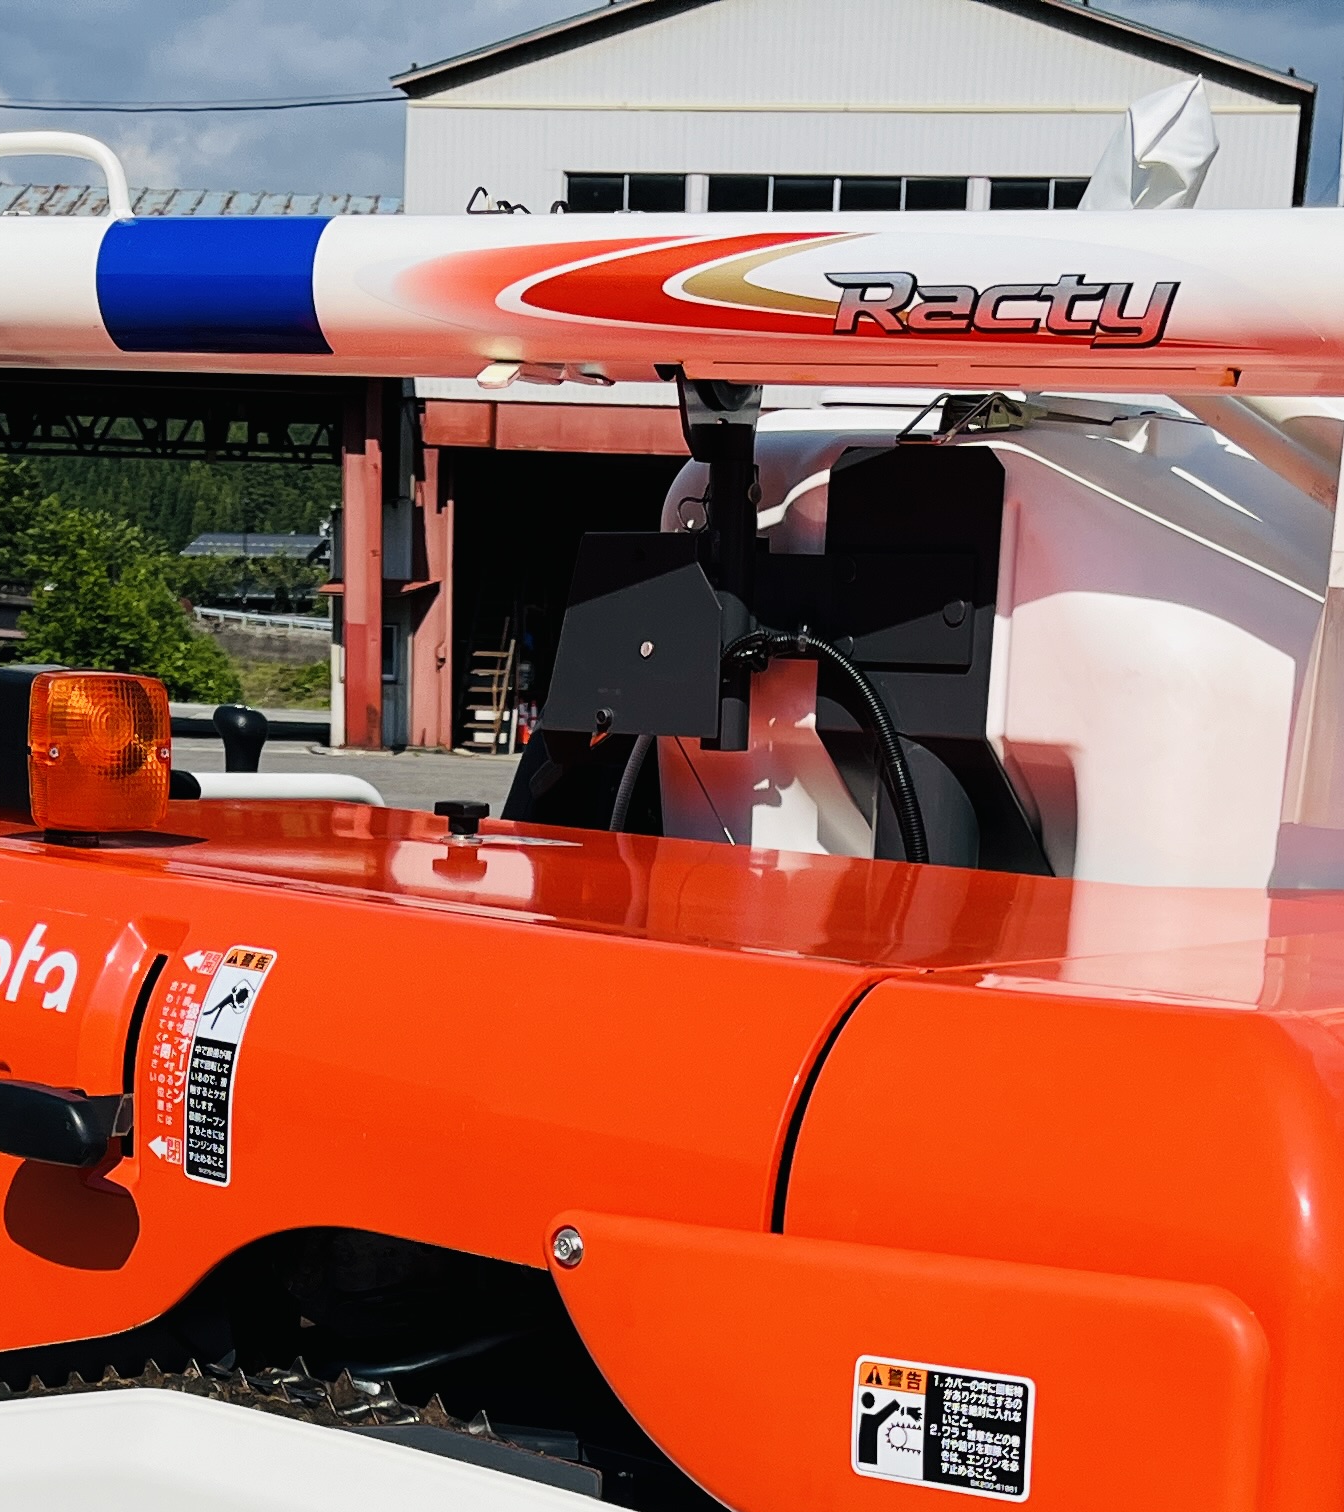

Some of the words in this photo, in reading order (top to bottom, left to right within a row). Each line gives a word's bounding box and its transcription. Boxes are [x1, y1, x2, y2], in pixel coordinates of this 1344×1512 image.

[825, 271, 1180, 349] Racty
[887, 1366, 923, 1391] 警告
[942, 1413, 974, 1429] いこと。
